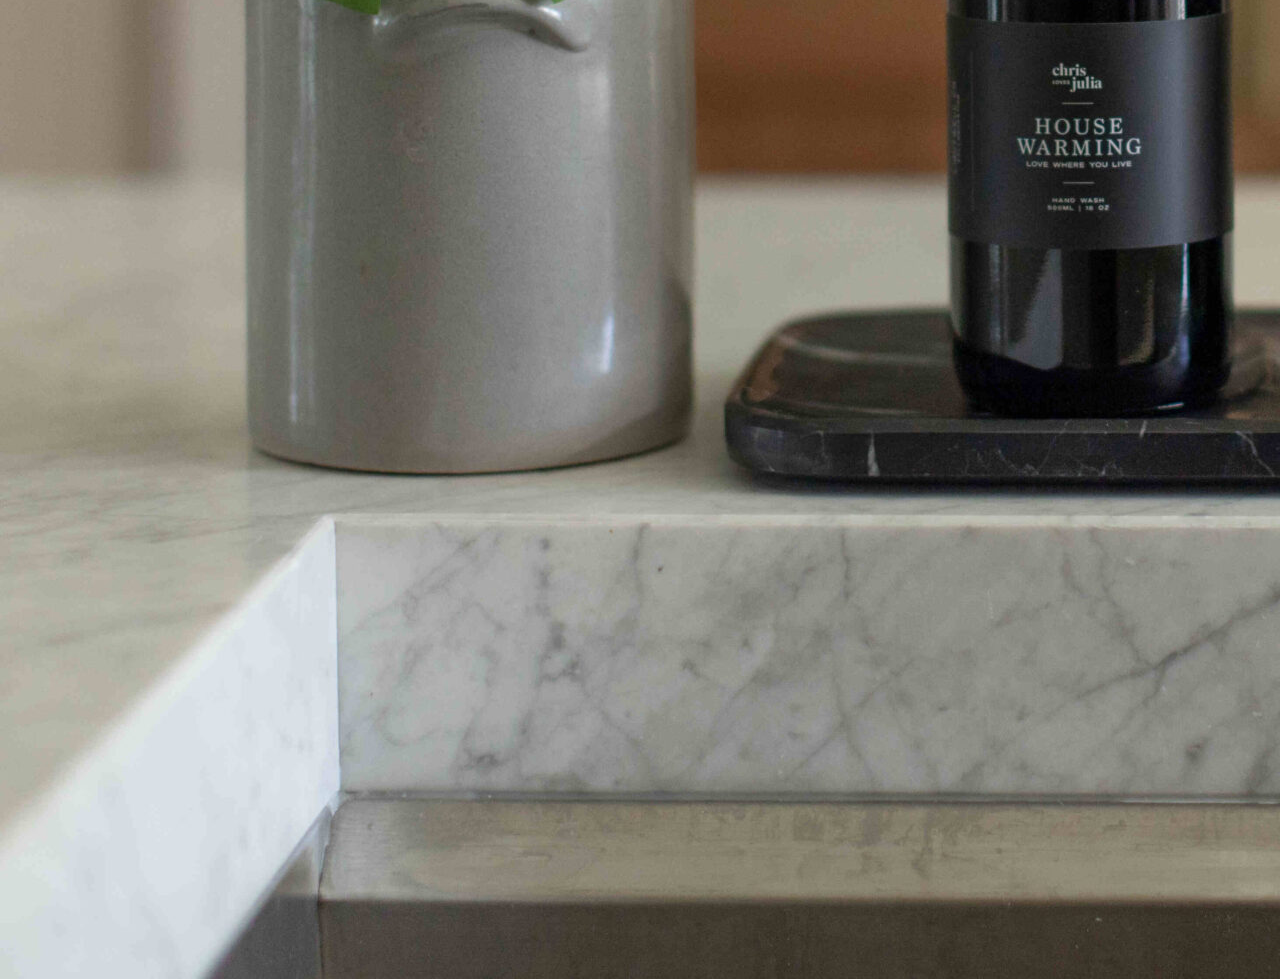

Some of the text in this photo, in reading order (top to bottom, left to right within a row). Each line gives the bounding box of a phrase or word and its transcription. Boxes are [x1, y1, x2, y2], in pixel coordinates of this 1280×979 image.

[1052, 63, 1087, 76] chris
[1069, 76, 1103, 93] julia
[1034, 117, 1124, 135] HOUSE
[1017, 138, 1143, 156] WARMING
